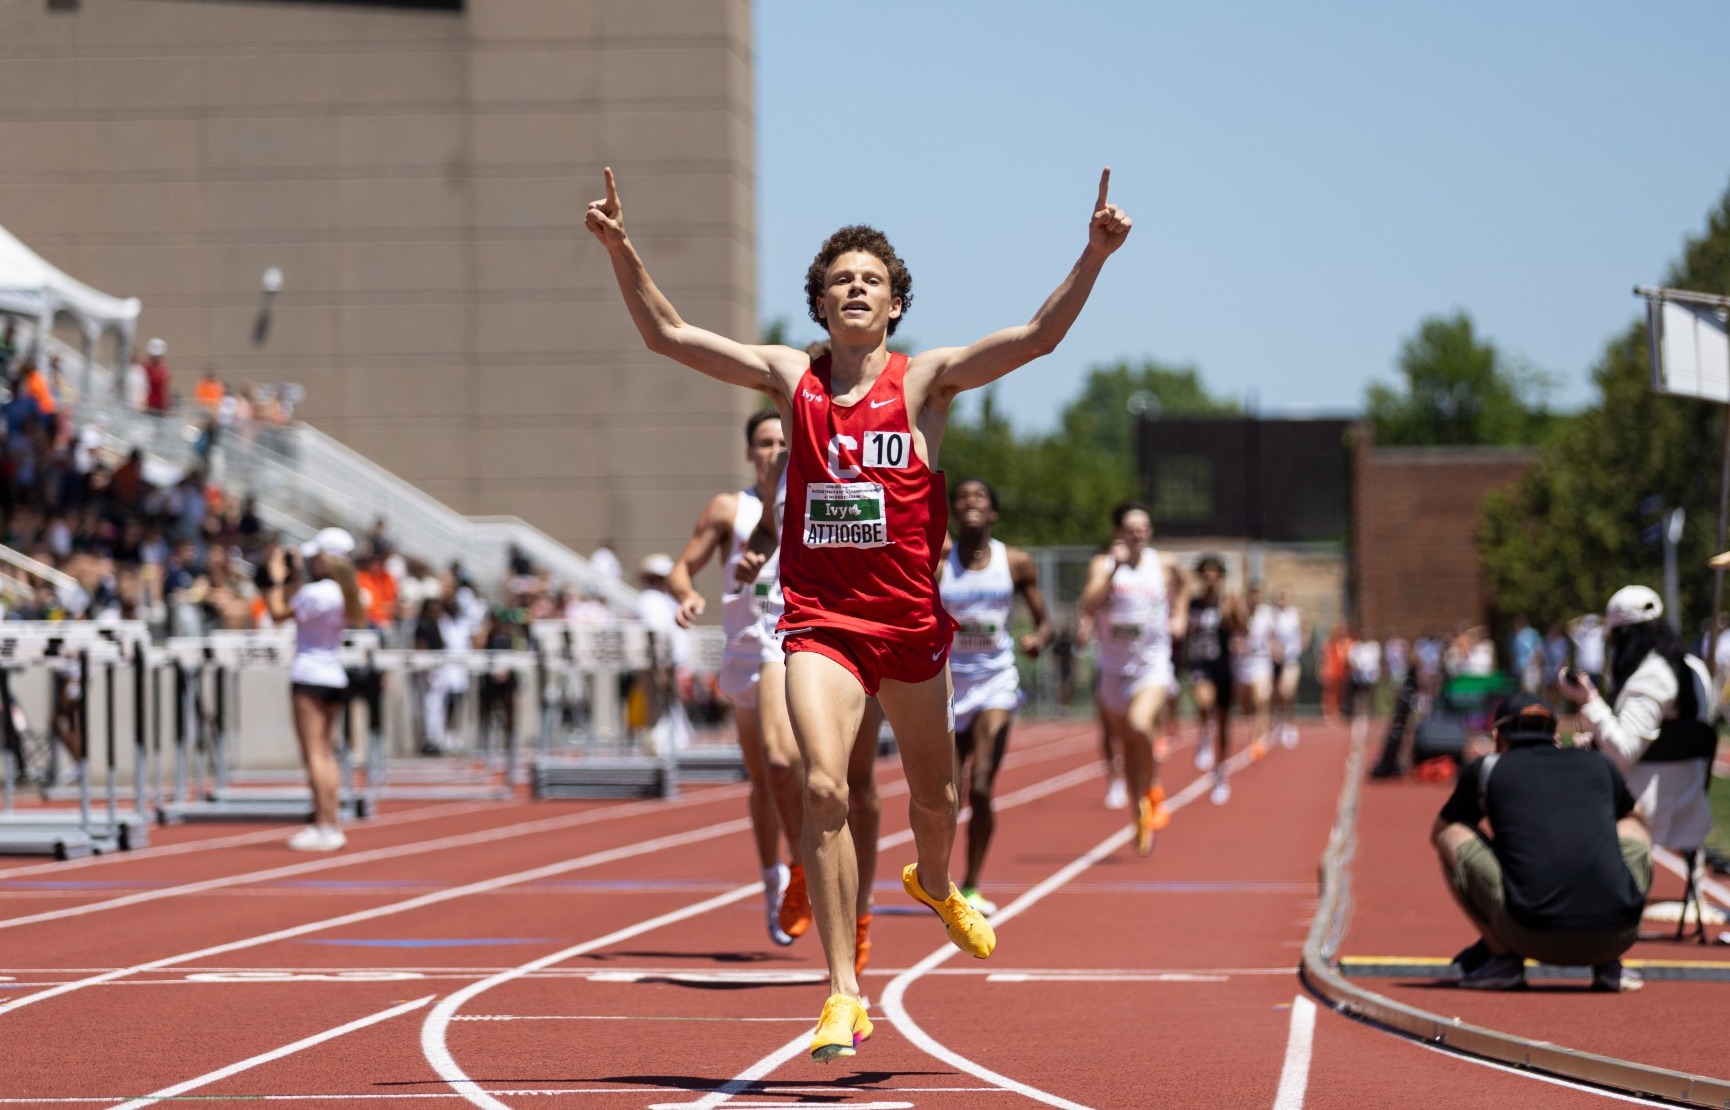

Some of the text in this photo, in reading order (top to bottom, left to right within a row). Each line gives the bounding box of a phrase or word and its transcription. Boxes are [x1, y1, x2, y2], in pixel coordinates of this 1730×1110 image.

[802, 389, 816, 402] Ivy
[828, 434, 862, 479] C
[872, 433, 903, 467] 10
[825, 503, 848, 519] Ivy
[807, 523, 883, 544] ATTIOGBE
